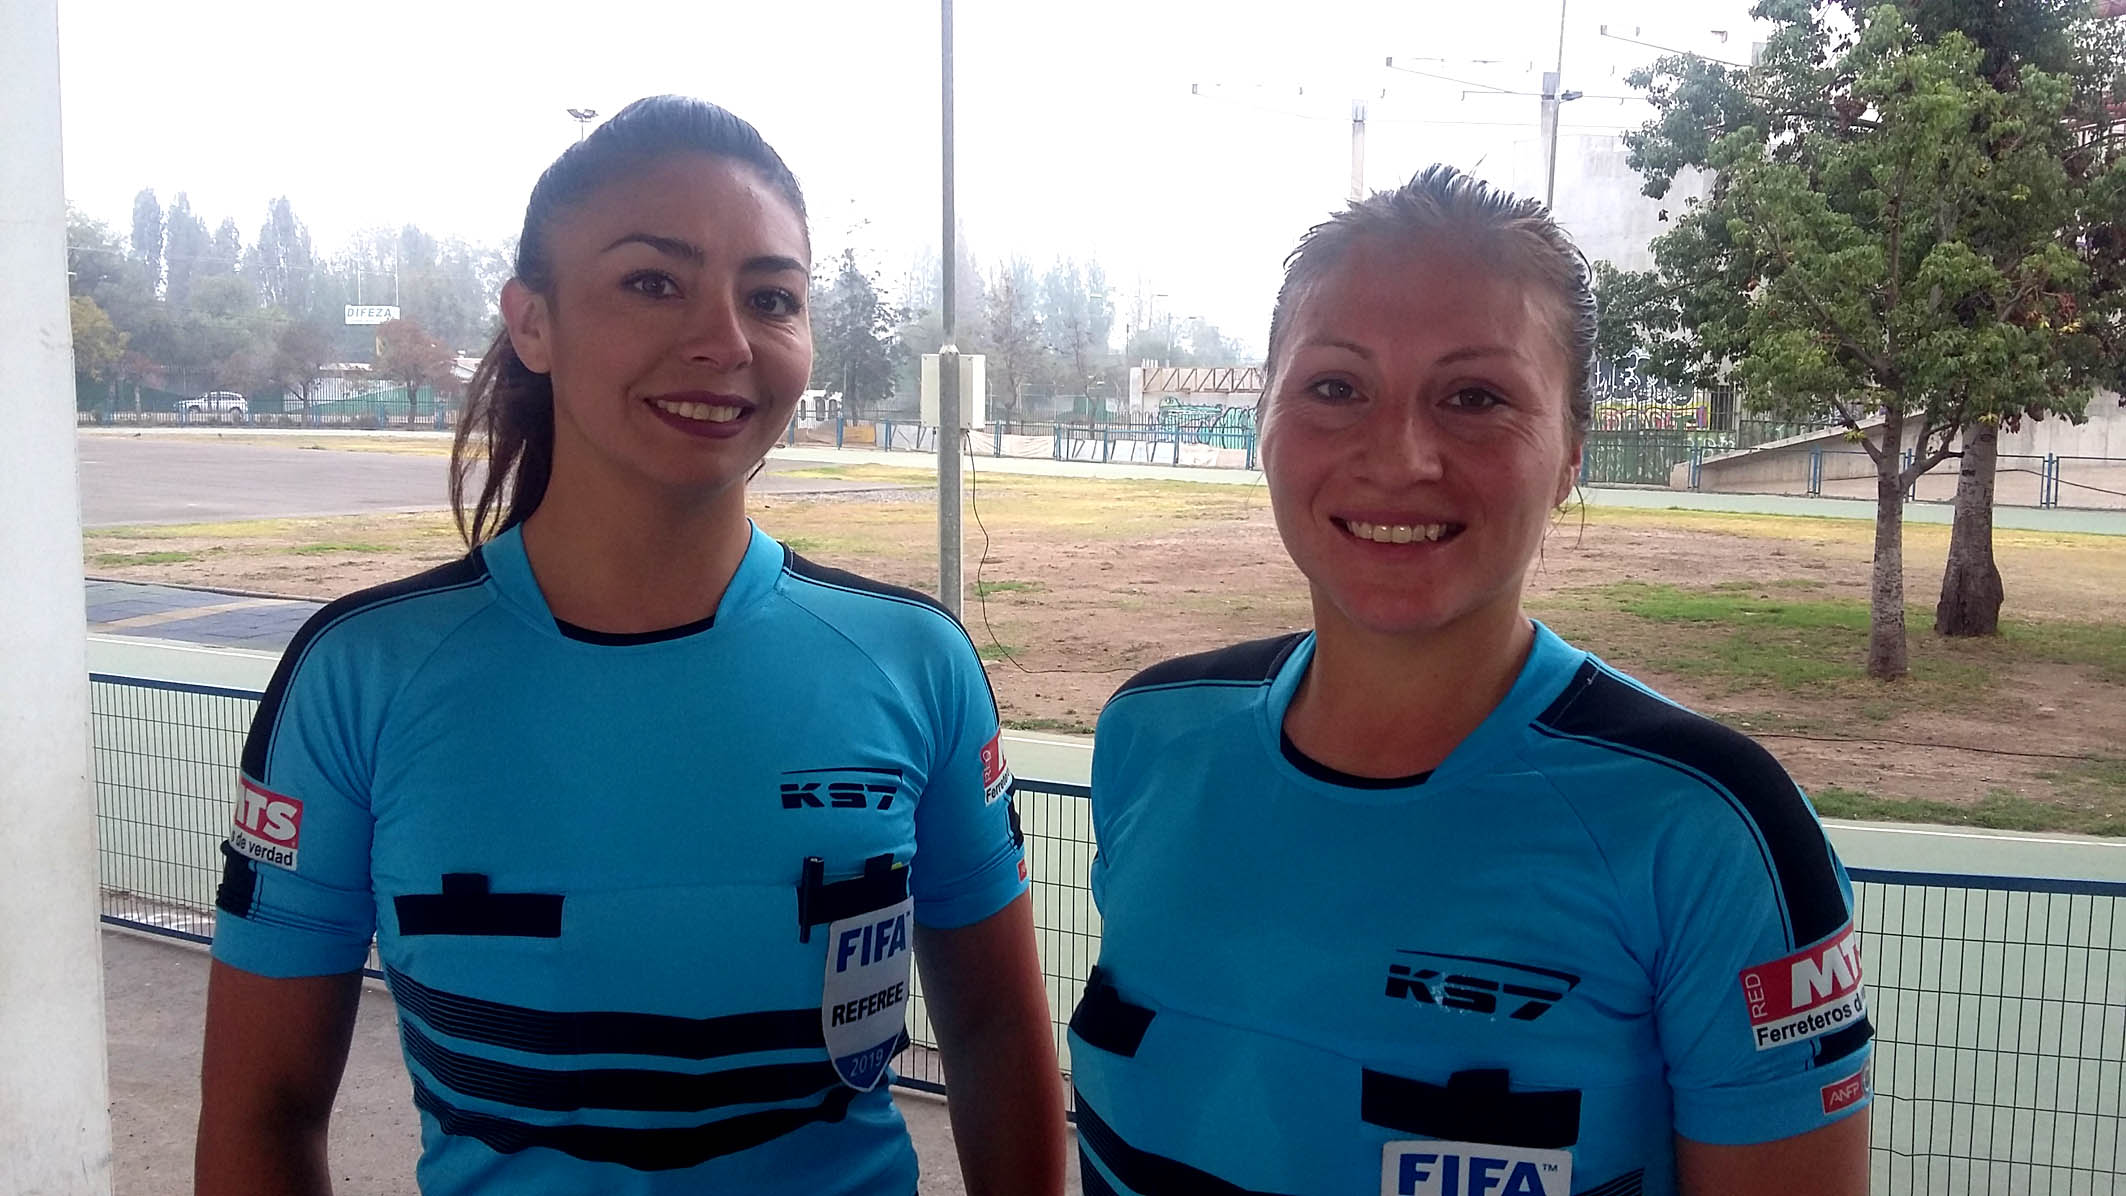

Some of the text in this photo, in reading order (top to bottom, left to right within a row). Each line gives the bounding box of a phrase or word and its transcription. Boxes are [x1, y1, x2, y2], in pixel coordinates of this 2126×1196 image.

[347, 308, 392, 317] DIFEZA
[780, 783, 897, 810] KS7
[249, 841, 293, 866] verdad
[836, 913, 906, 973] FIFA
[1792, 932, 1862, 1009] MT
[832, 981, 904, 1027] REFEREE
[1385, 964, 1562, 1021] KS7
[1745, 973, 1768, 1018] RED
[1757, 1005, 1851, 1046] Ferreteros
[850, 1050, 883, 1077] 2019
[1829, 1082, 1859, 1105] ANFP
[1398, 1153, 1547, 1196] FIFA
